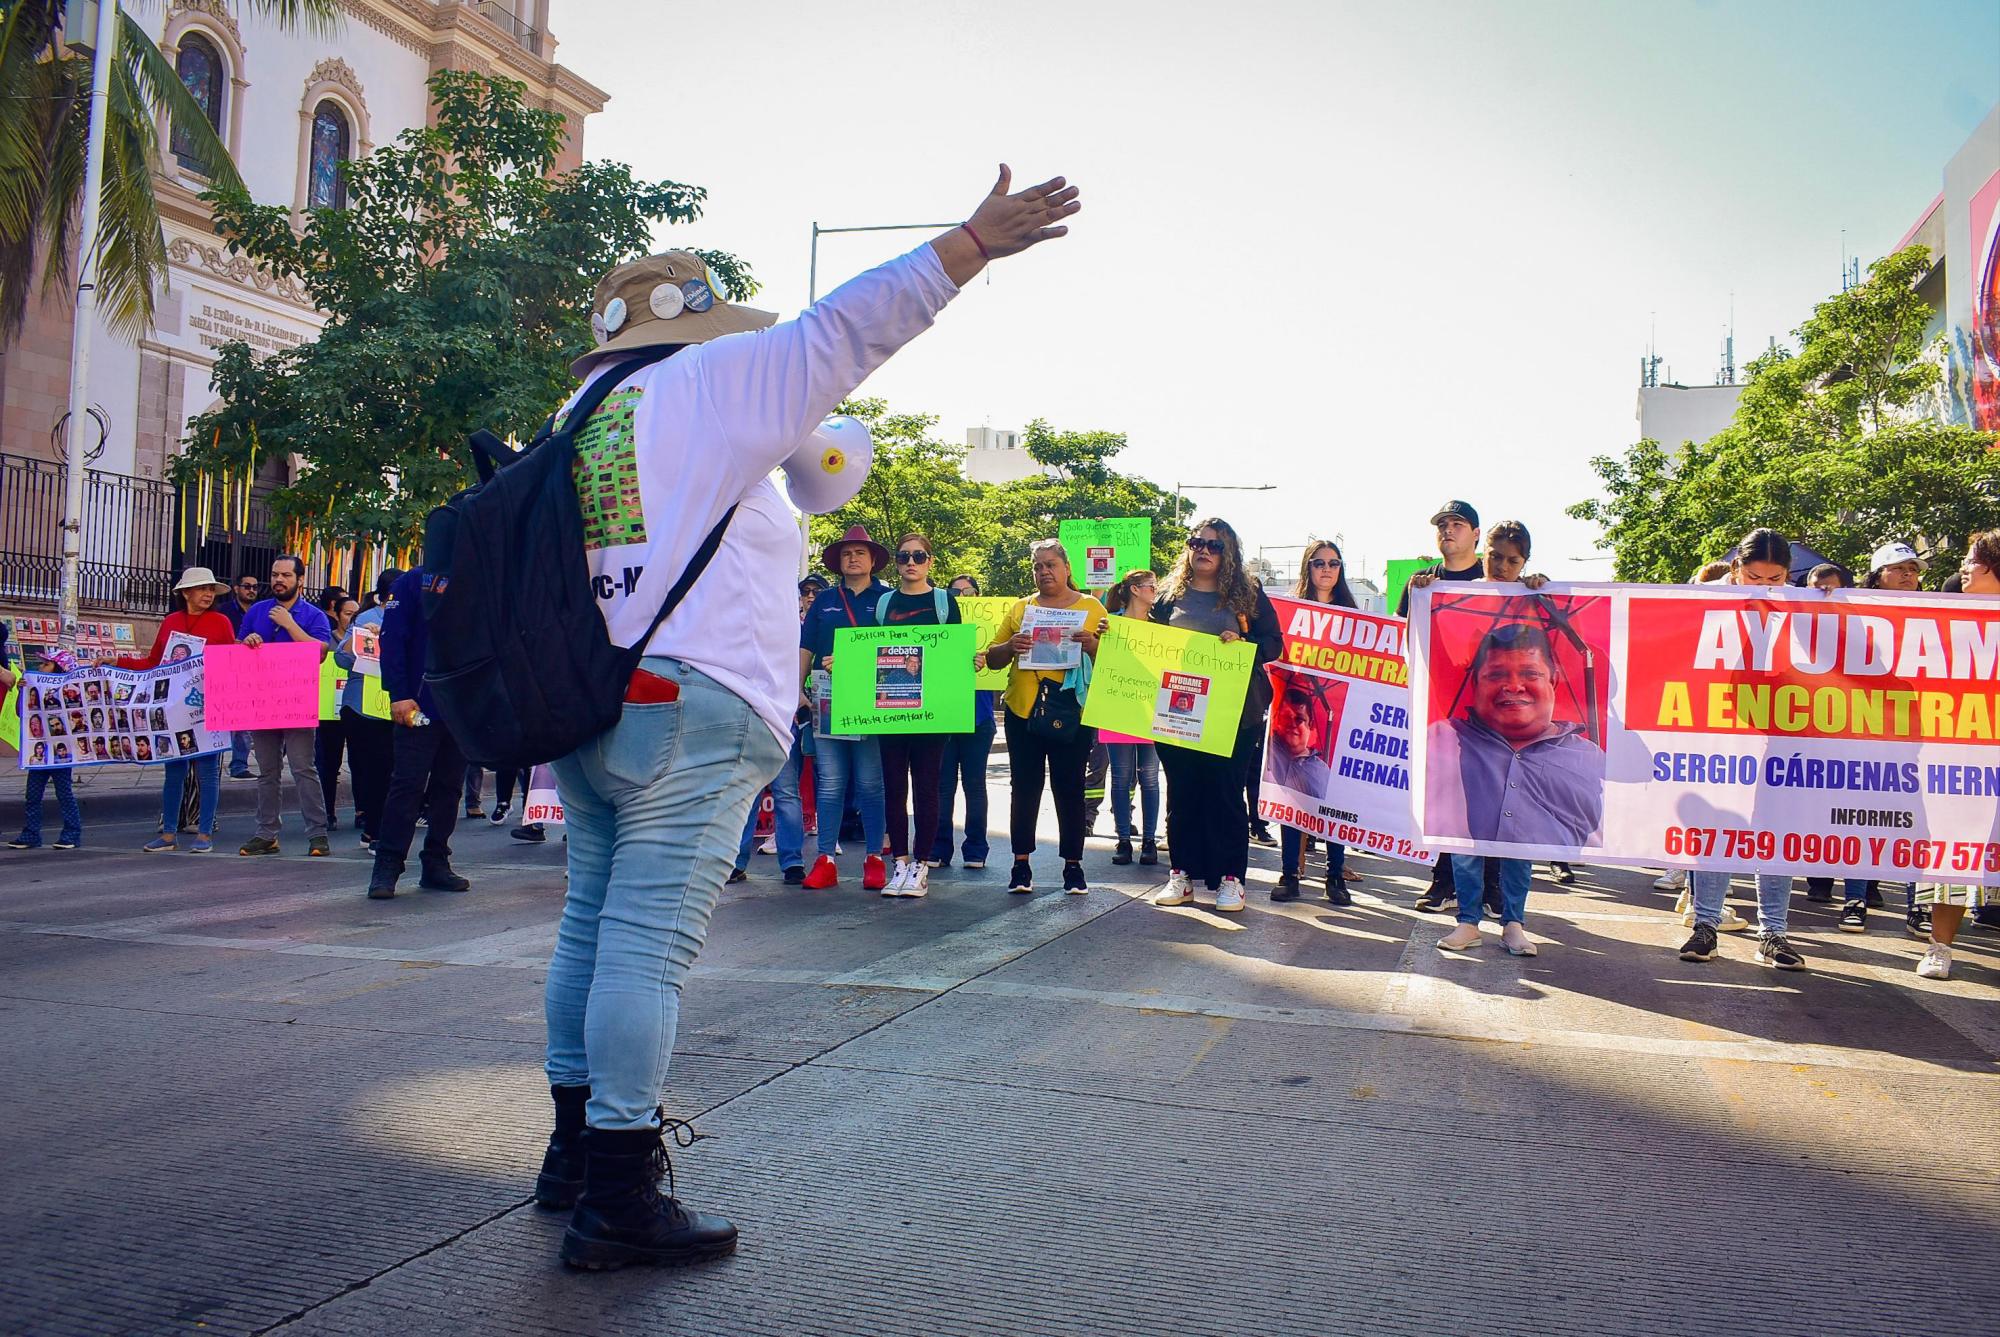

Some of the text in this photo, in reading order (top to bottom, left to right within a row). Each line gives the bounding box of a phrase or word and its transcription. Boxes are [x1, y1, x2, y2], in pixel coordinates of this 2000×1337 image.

[202, 305, 213, 317] EL
[1116, 531, 1141, 547] BIEN
[912, 627, 949, 648] Sergio
[888, 646, 918, 655] debate
[36, 675, 61, 685] VOCES
[114, 671, 134, 681] VIDA
[150, 666, 181, 679] DIGNIDAD
[1169, 675, 1203, 688] AYUDAME
[1370, 703, 1408, 729] SER
[1656, 681, 2000, 741] A ENCONTRA
[1652, 752, 1756, 785] SERGIO
[1765, 753, 1920, 794] CÁRDENAS
[528, 805, 548, 820] 667
[1318, 805, 1358, 823] INFORMES
[1830, 808, 1913, 829] INFORMES
[1269, 801, 1294, 822] 759
[1295, 809, 1324, 834] 0900
[1327, 821, 1337, 837] Y
[1338, 824, 1366, 844] 667
[1367, 832, 1395, 851] 573
[1664, 827, 2000, 872] 667 759 0900 Y 667 573
